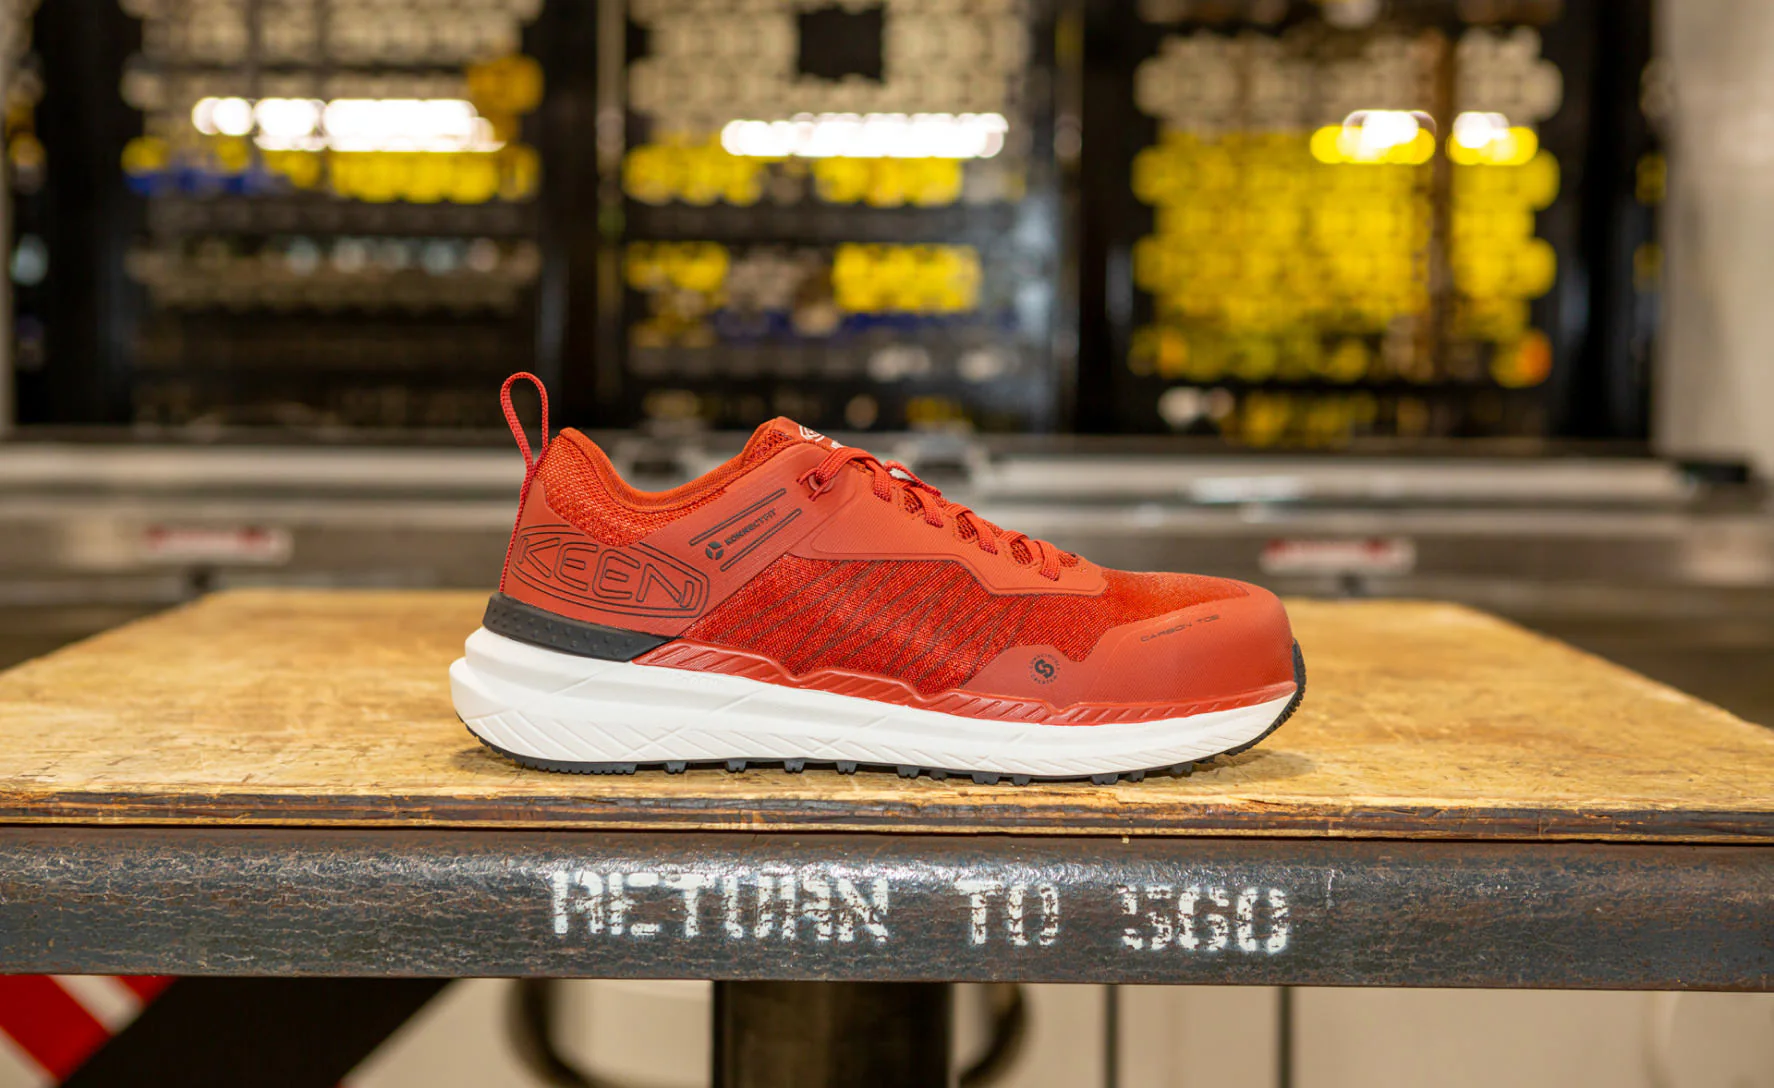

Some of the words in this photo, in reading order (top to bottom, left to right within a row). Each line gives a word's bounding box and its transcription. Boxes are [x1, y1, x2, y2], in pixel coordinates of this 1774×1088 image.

[517, 536, 696, 609] KEEN
[1140, 622, 1193, 642] CARBON
[552, 869, 890, 943] RETURN
[952, 879, 1059, 946] TO
